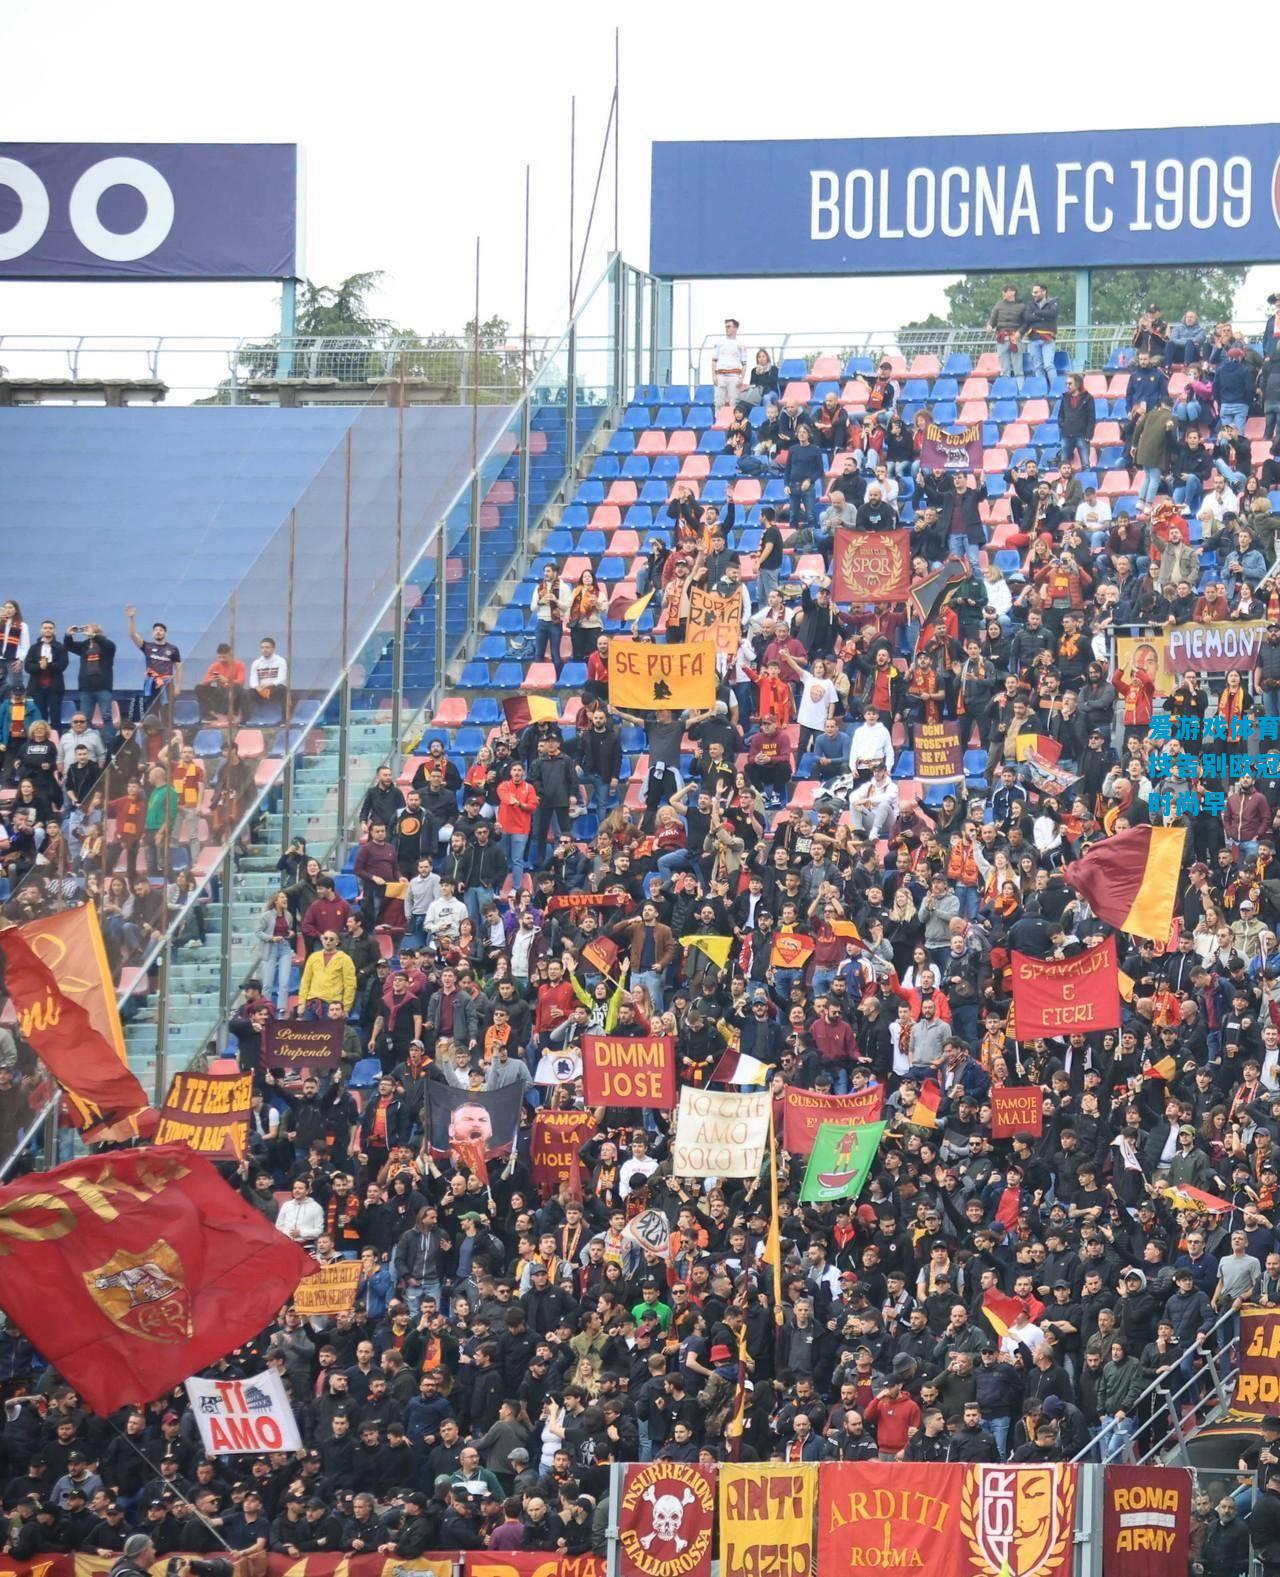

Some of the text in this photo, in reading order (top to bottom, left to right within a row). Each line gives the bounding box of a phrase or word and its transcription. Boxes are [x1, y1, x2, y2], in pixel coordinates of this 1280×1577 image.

[810, 156, 1252, 240] BOLOGNA FC 1909
[853, 558, 891, 574] SPQR
[616, 652, 640, 675] SE
[922, 724, 944, 736] OGNI
[1020, 951, 1110, 980] SPAVALDI
[1063, 984, 1075, 1000] E
[1042, 1003, 1094, 1025] FIERI
[275, 1028, 332, 1042] Pensiero
[274, 1045, 331, 1060] Stupendo
[595, 1041, 665, 1068] DIMMI
[167, 1075, 182, 1108] A
[182, 1078, 208, 1113] TE
[788, 1093, 879, 1108] QUESTA MAGLIA
[995, 1097, 1037, 1109] FAMOJE
[687, 1095, 765, 1118] IO CHE
[998, 1111, 1038, 1126] MALE
[544, 1131, 579, 1144] E LA
[696, 1122, 747, 1144] AMO
[677, 1147, 732, 1171] SOLO
[214, 1382, 248, 1414] TI
[209, 1417, 282, 1450] AMO
[622, 1463, 714, 1513] INSURREZIONE
[1115, 1487, 1179, 1511] ROMA
[829, 1489, 951, 1534] ARDITI
[621, 1528, 712, 1576] GIALLOROSSA
[1116, 1529, 1175, 1553] ARMY
[851, 1546, 924, 1567] ROMA
